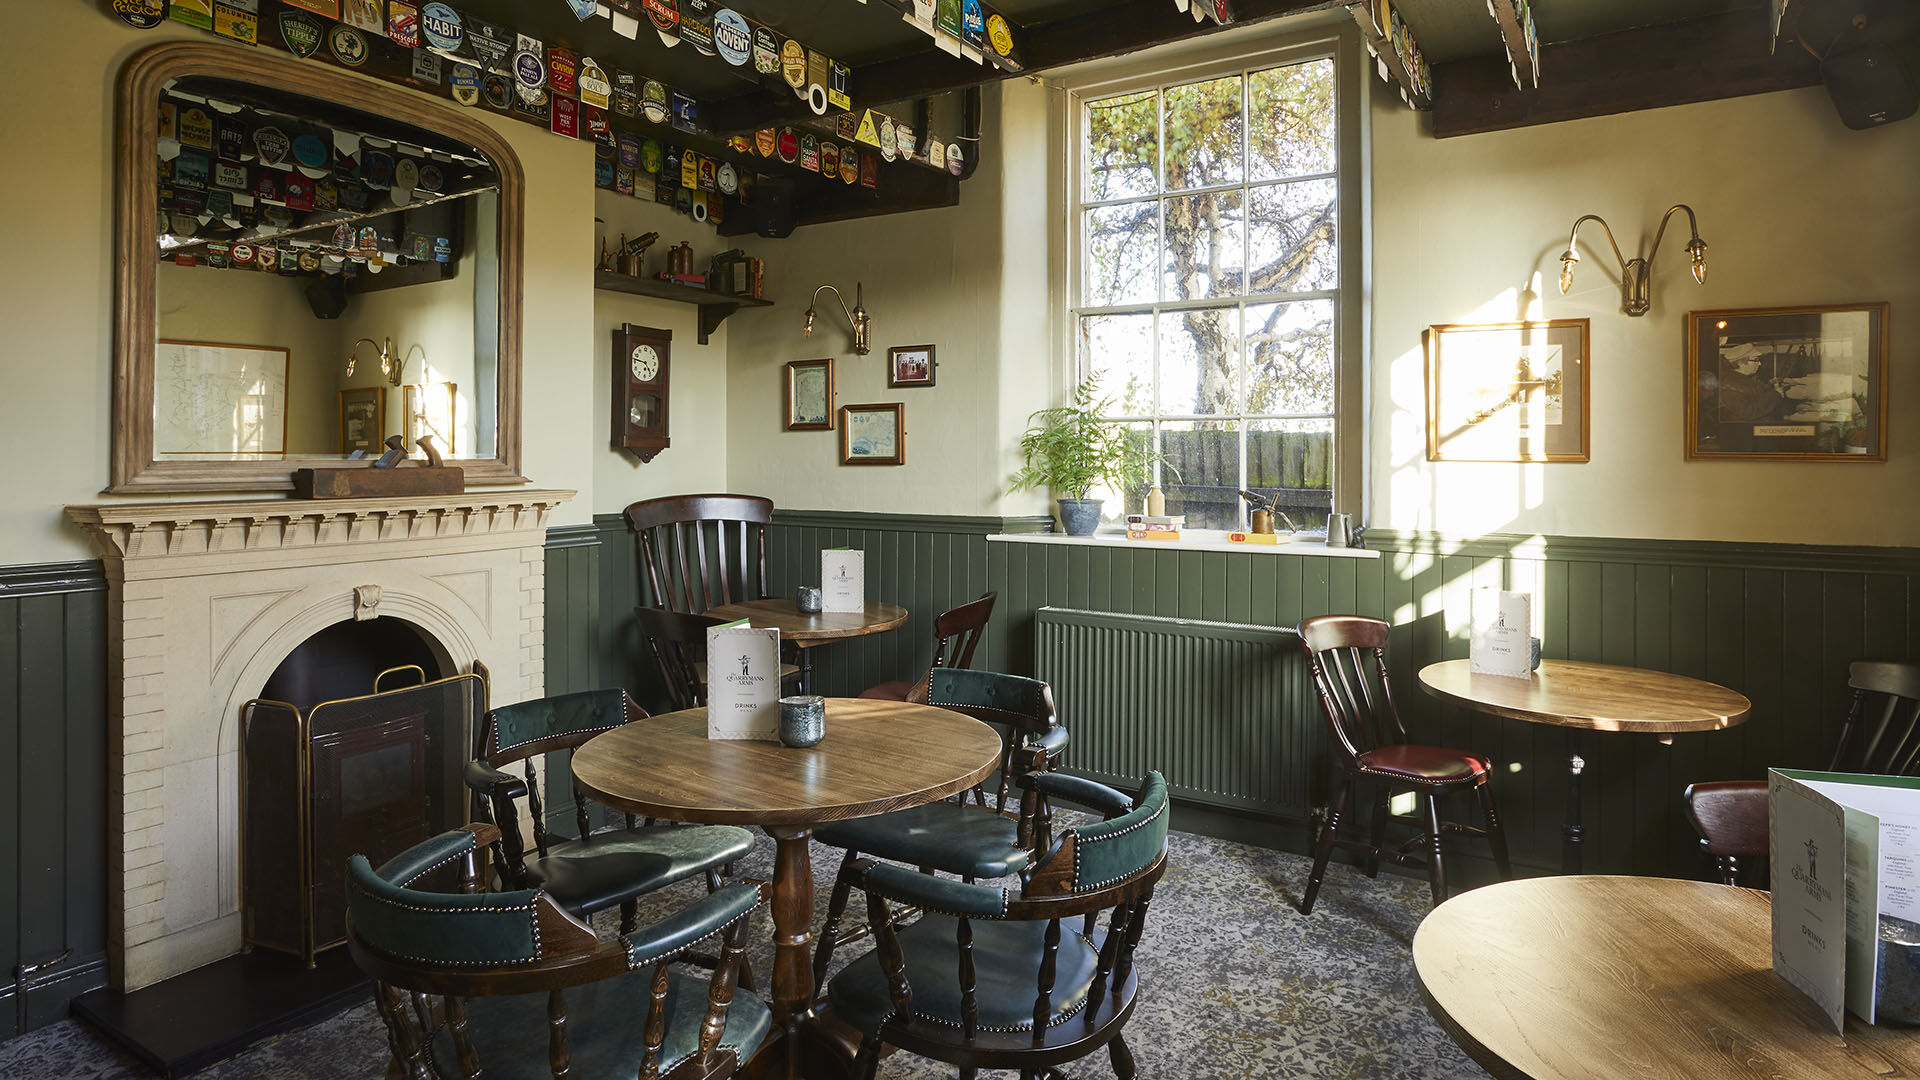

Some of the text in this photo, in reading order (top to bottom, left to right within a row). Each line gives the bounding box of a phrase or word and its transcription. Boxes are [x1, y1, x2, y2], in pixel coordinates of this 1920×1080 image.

[113, 0, 162, 16] Peloton
[216, 6, 257, 23] COLUMBUS
[649, 0, 674, 20] SCRUM
[284, 19, 318, 36] SHERIFF'S
[423, 15, 462, 37] HABIT
[286, 27, 316, 43] TIPPLE
[389, 31, 418, 45] PRESCOTT
[469, 35, 488, 46] NATIVE
[716, 27, 750, 52] ADVENT
[551, 60, 575, 76] CWRW
[1801, 924, 1826, 949] DRINKS
